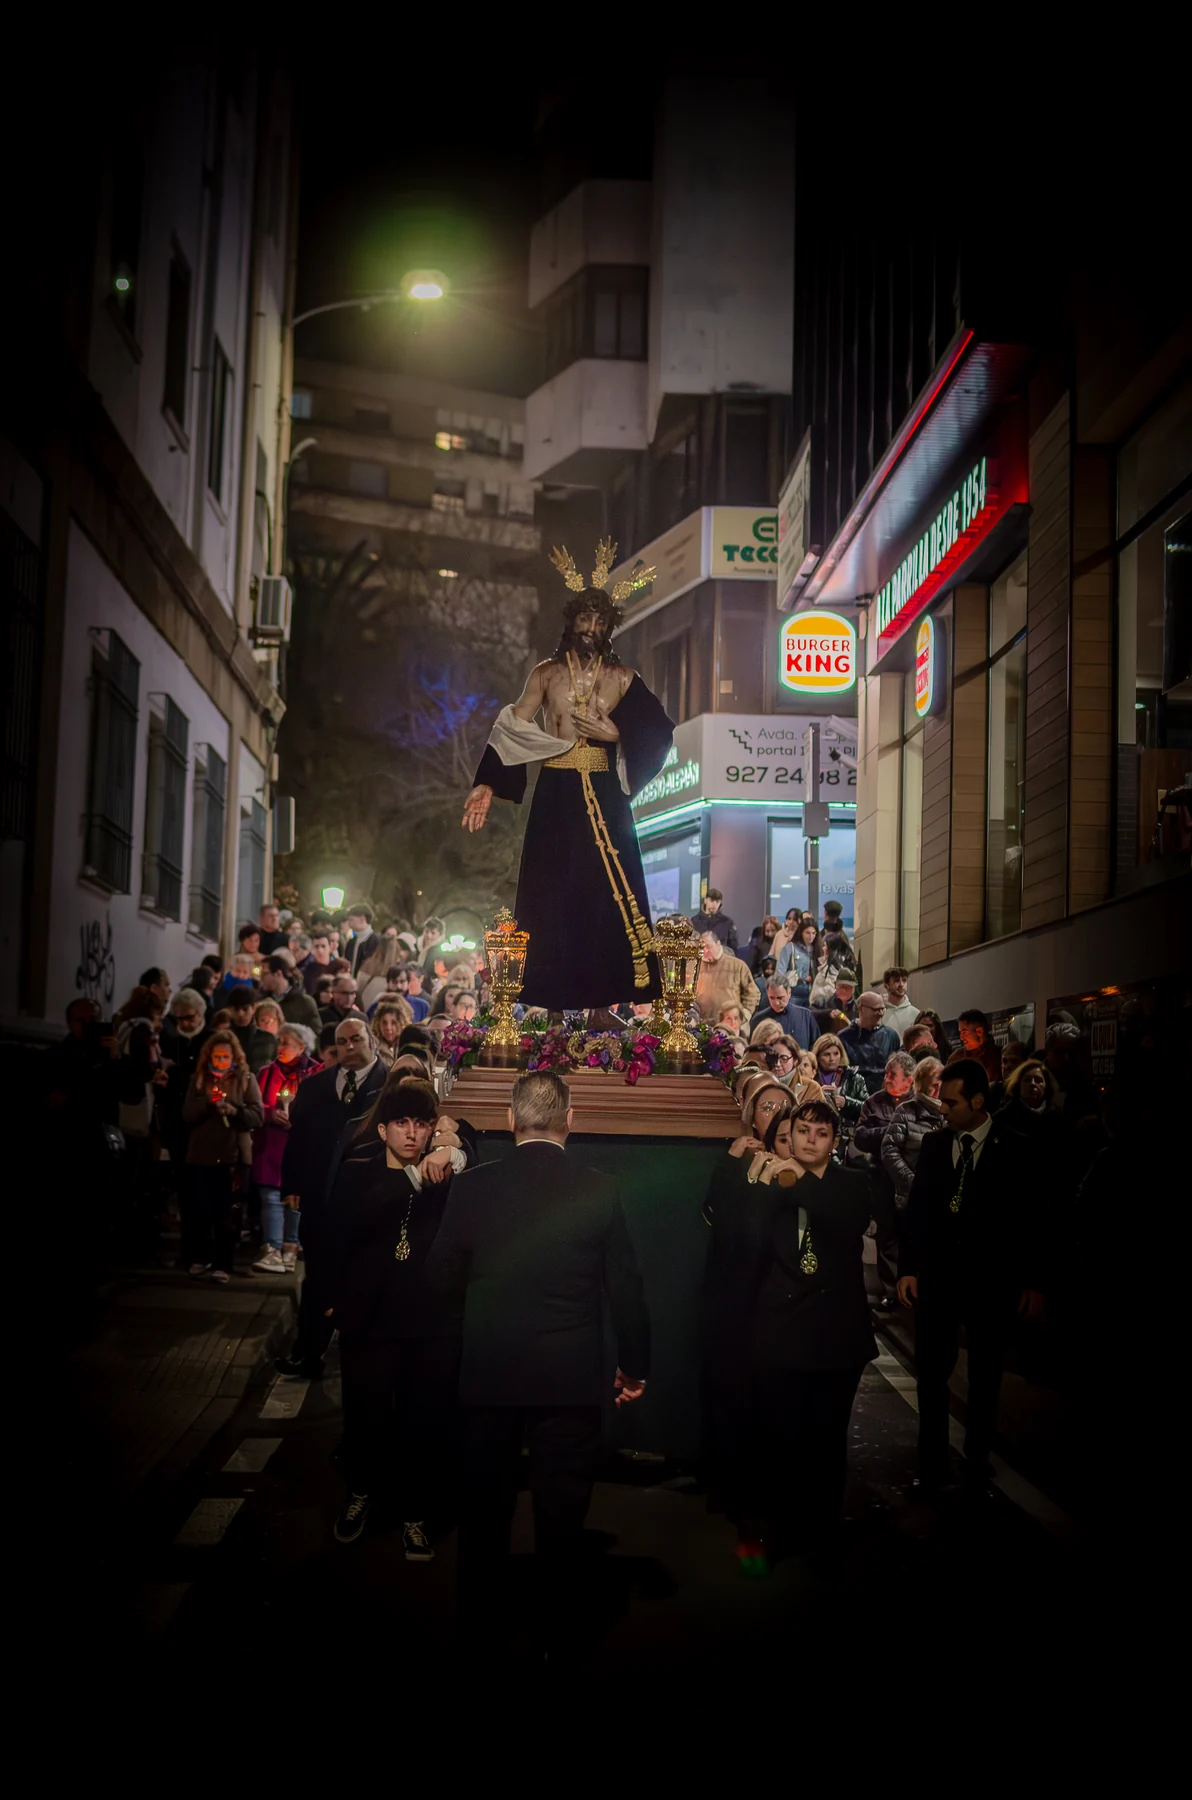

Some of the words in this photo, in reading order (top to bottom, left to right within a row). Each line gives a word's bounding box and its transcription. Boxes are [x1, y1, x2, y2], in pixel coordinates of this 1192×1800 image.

[892, 530, 930, 621] PARRILLA
[930, 490, 960, 573] DESDE
[961, 455, 987, 533] 1954
[786, 638, 851, 652] BURGER
[786, 653, 851, 673] KING
[758, 728, 798, 741] Avda.
[757, 746, 797, 758] portal
[726, 766, 769, 783] 927
[775, 767, 804, 784] 24
